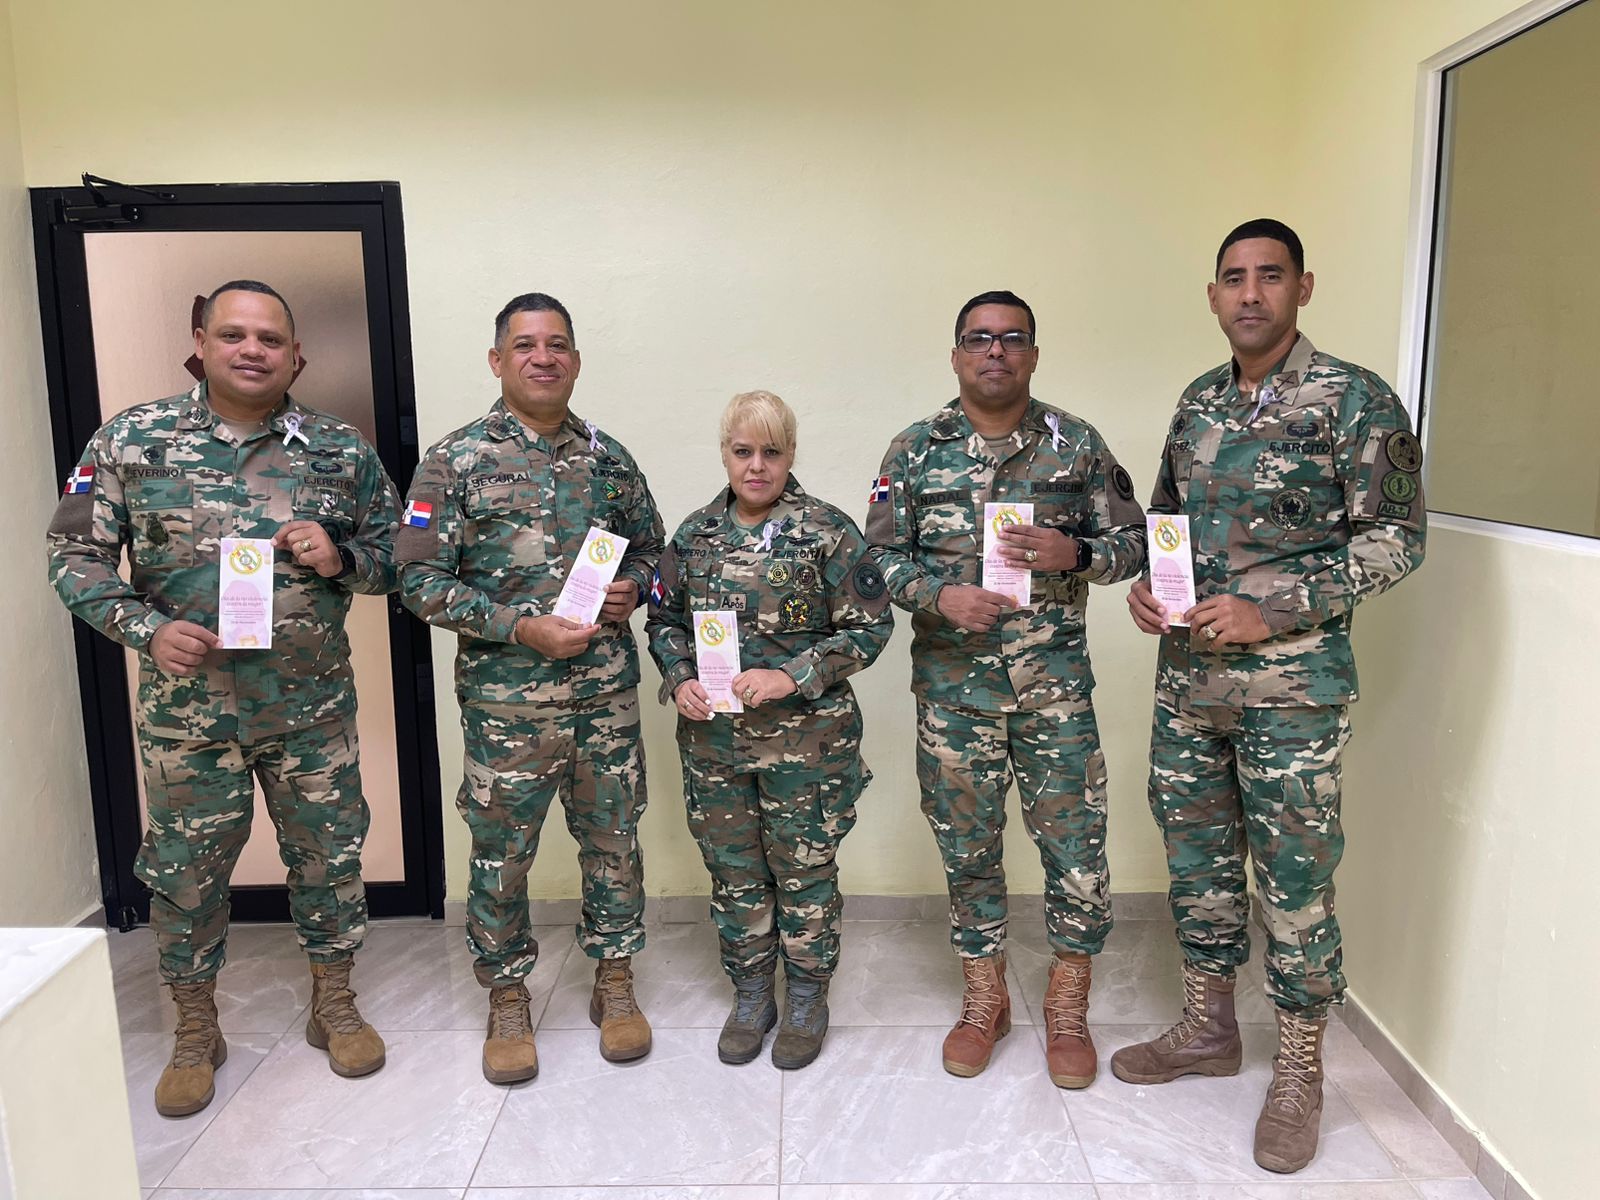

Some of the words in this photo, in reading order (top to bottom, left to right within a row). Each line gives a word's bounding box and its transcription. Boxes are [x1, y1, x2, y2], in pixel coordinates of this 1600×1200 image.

[1269, 441, 1330, 454] EJERCITO
[471, 473, 526, 487] SEGURA
[920, 490, 961, 505] NADAL
